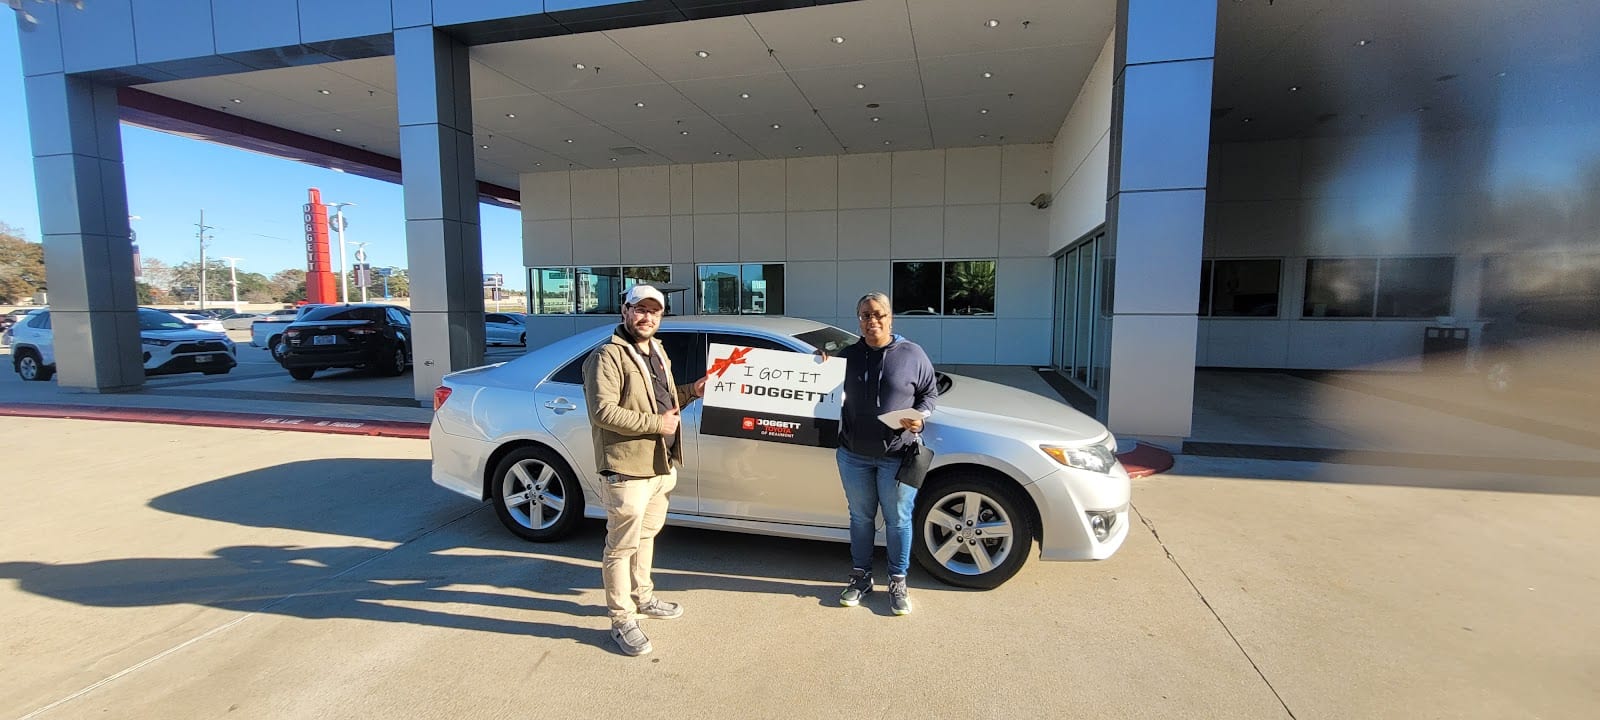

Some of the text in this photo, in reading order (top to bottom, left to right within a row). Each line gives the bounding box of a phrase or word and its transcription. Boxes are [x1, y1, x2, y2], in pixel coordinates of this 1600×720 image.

[304, 204, 315, 271] DOGGETT
[743, 365, 821, 384] I GOT IT
[714, 381, 834, 403] AT DOGGETT!
[756, 418, 801, 430] DOGGETT
[765, 425, 792, 434] TOYOTA
